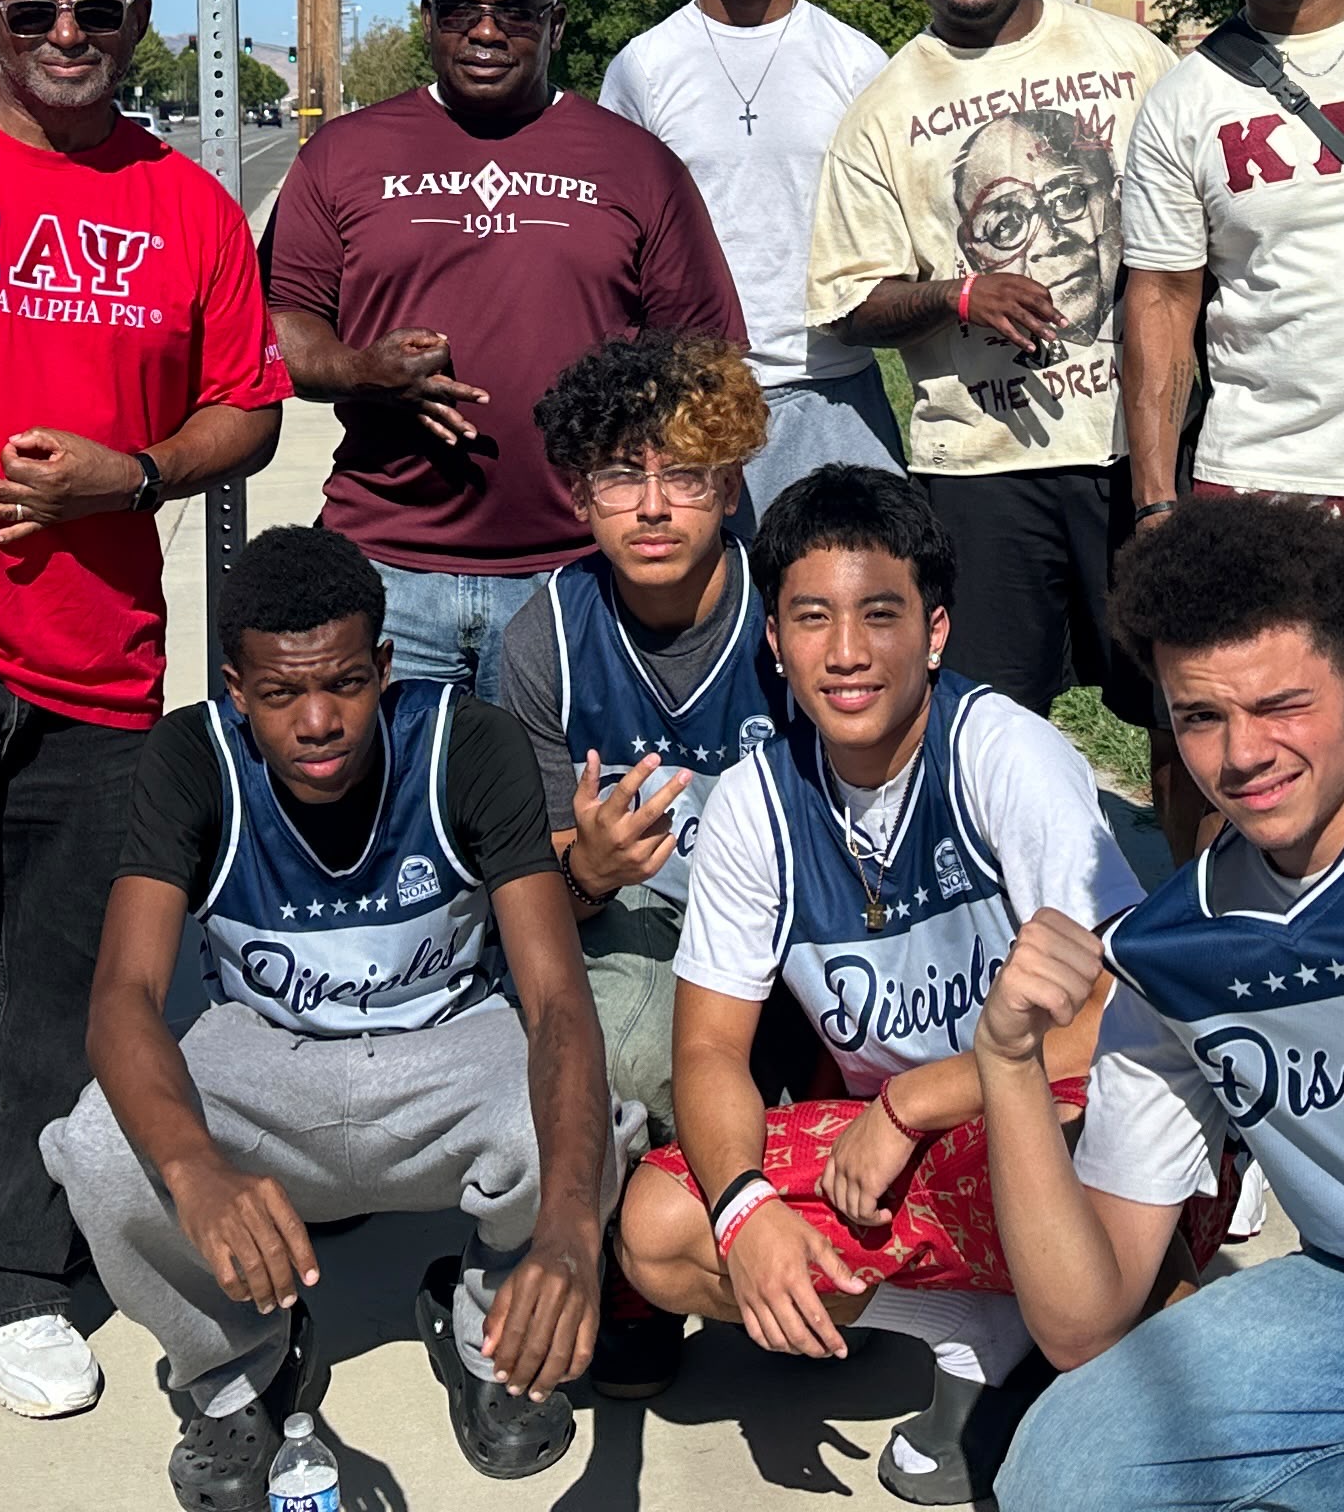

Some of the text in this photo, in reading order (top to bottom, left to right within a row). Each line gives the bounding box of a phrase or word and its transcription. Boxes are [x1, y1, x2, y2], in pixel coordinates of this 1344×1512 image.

[909, 71, 1137, 147] ACHIEVEMENT
[507, 171, 598, 205] NUPE
[462, 212, 518, 238] 1911
[16, 295, 101, 324] ALPHA
[966, 376, 1030, 414] THE
[399, 878, 439, 901] NOAH
[240, 926, 459, 1016] Disciples
